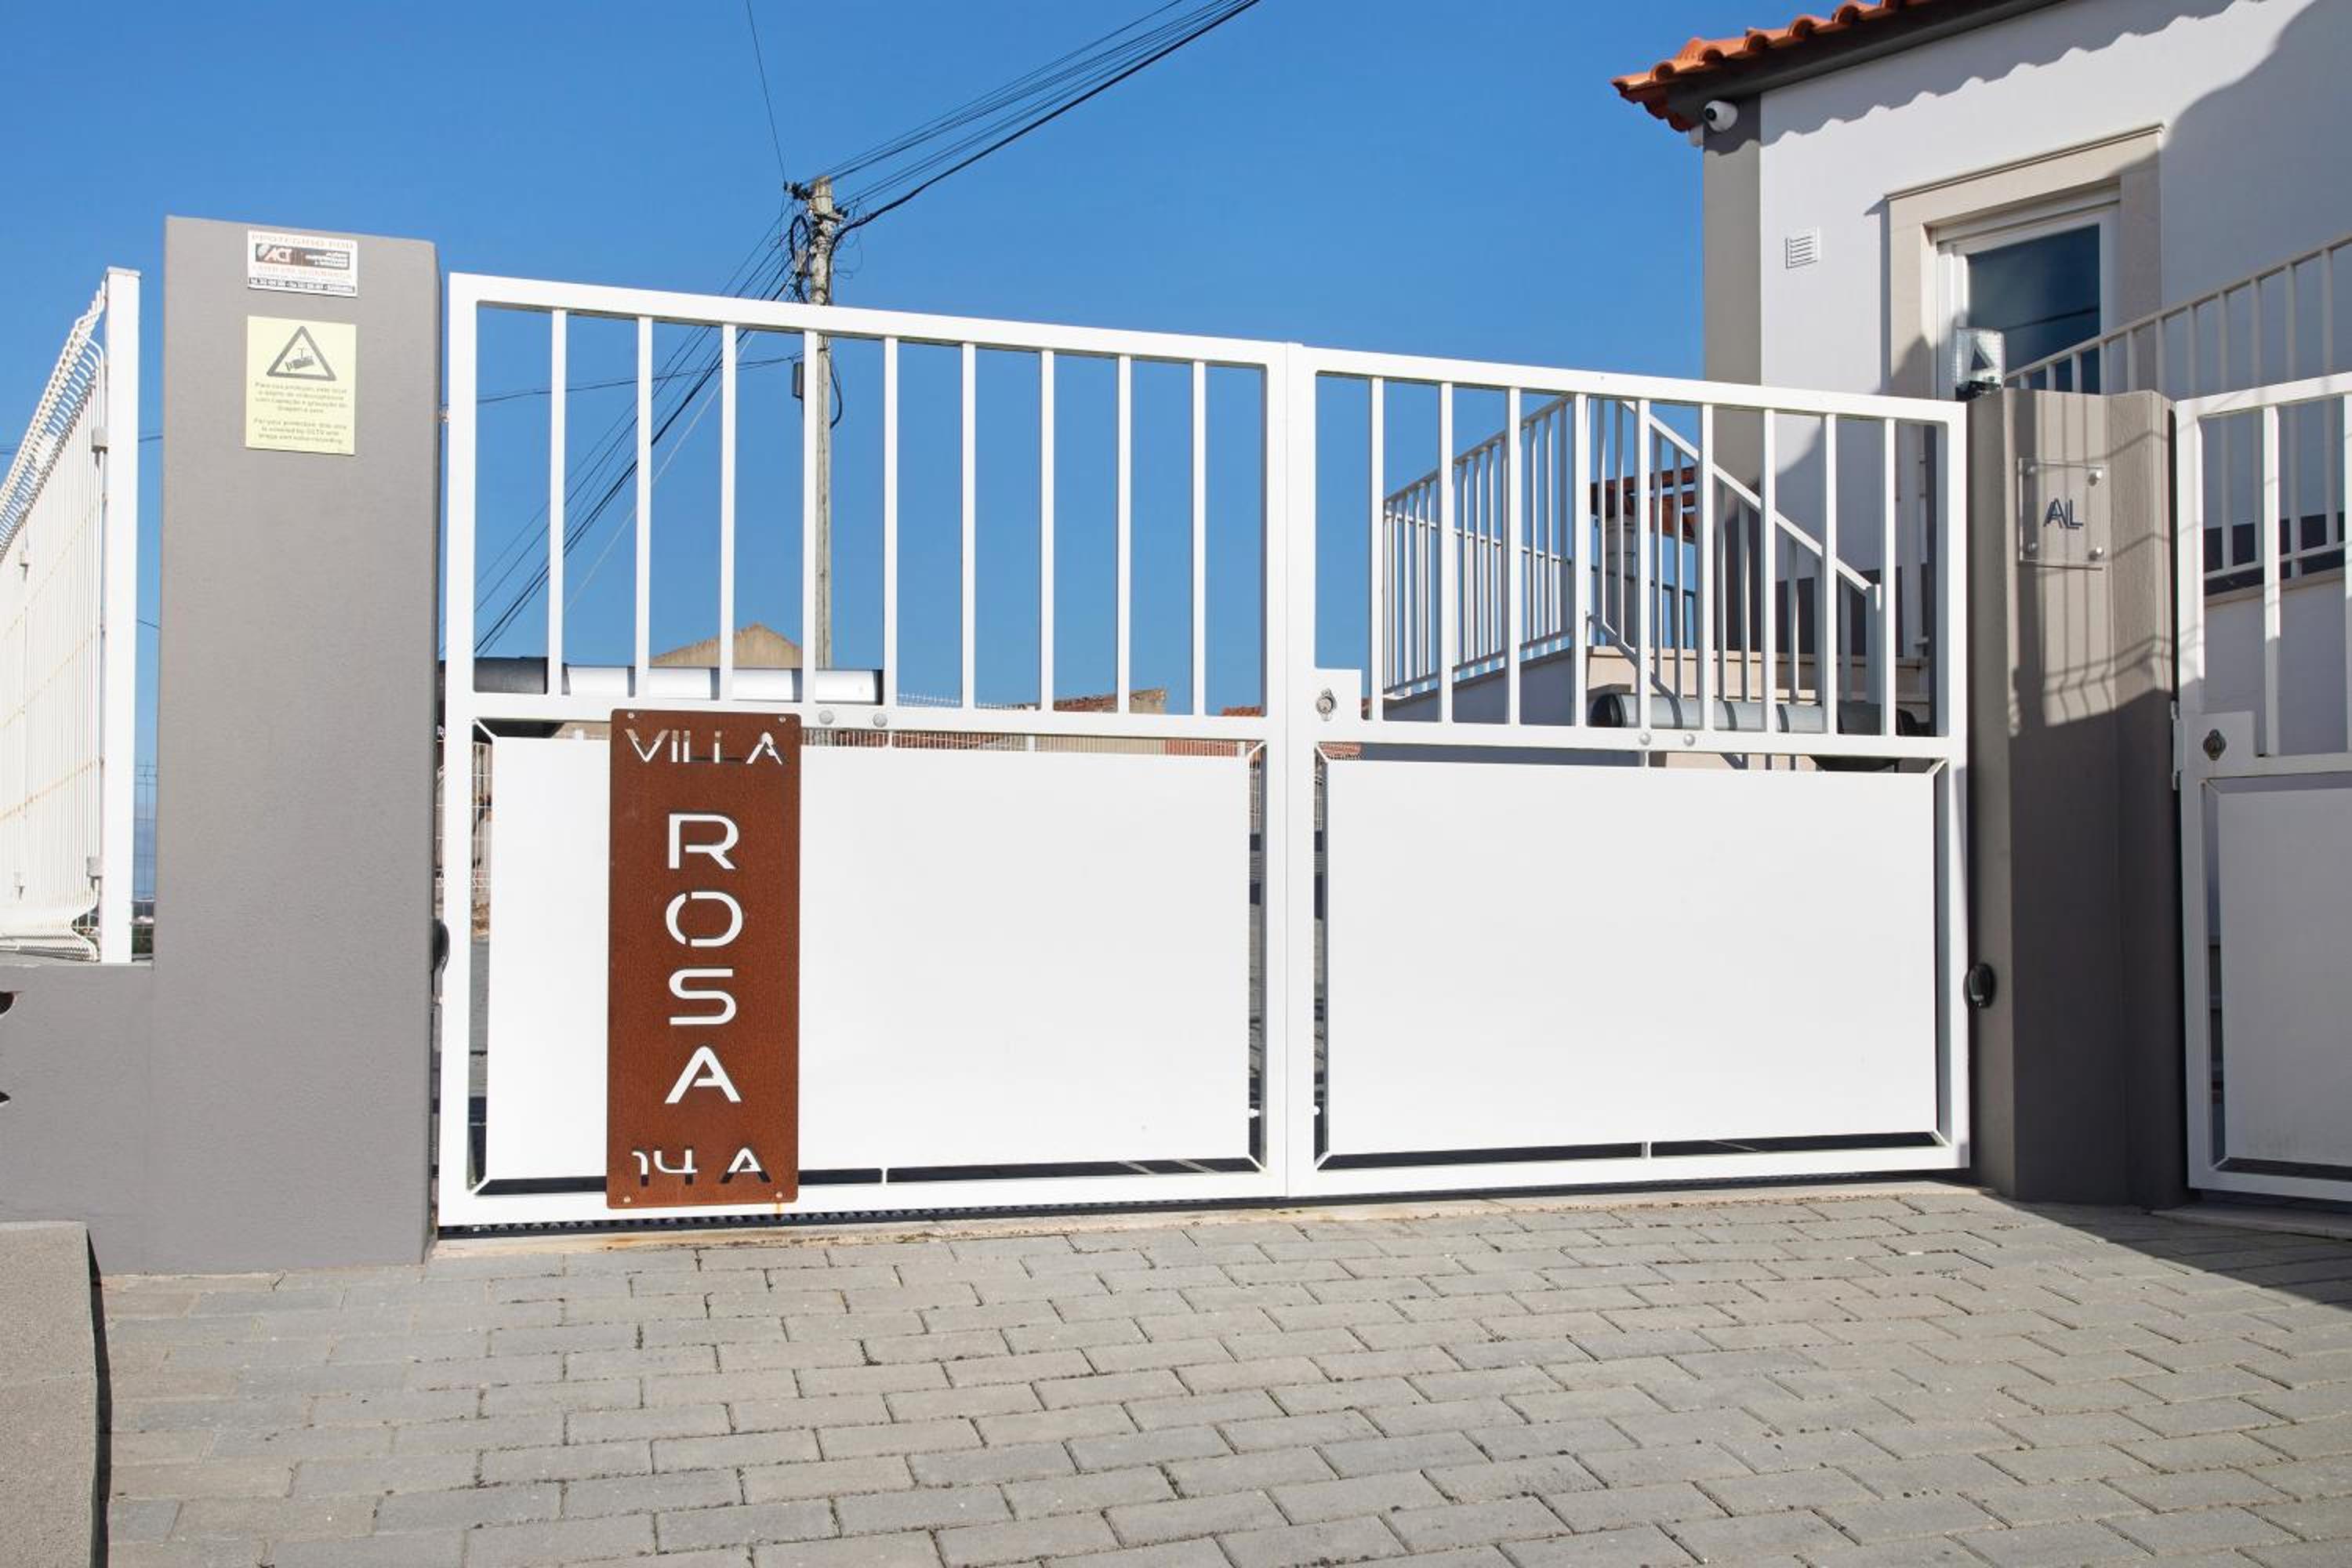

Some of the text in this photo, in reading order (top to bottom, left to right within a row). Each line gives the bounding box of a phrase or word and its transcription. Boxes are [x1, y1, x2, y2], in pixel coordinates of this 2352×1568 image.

[2043, 497, 2084, 529] AL
[625, 728, 783, 765] VILLA
[665, 813, 743, 1104] ROSA
[631, 1146, 771, 1186] 14 A
